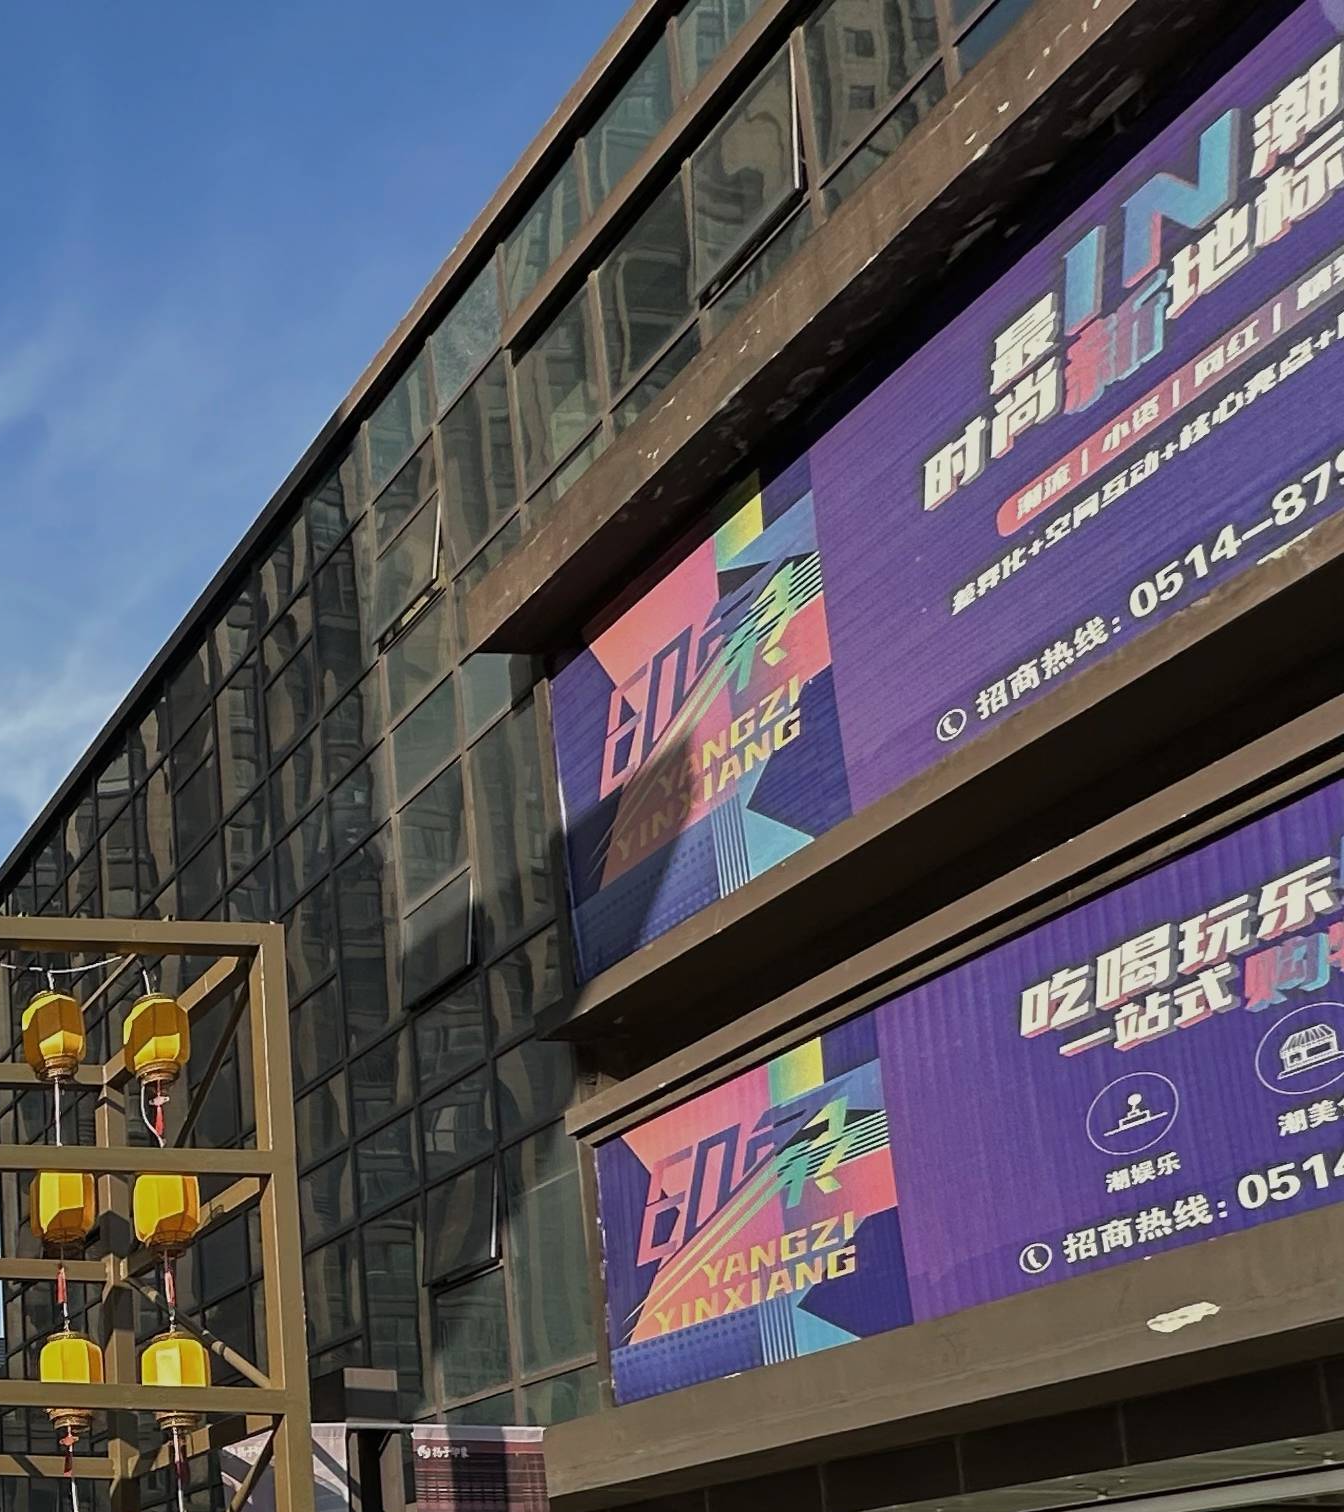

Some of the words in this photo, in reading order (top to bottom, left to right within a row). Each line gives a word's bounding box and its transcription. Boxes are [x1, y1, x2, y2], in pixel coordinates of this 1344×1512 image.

[951, 306, 1344, 616] 差异化+空间互动+核心亮点+
[1277, 1097, 1344, 1137] 潮美
[1105, 1151, 1182, 1194] 潮娱乐
[654, 1245, 857, 1334] YINXIANG
[702, 1210, 856, 1290] YANGZI
